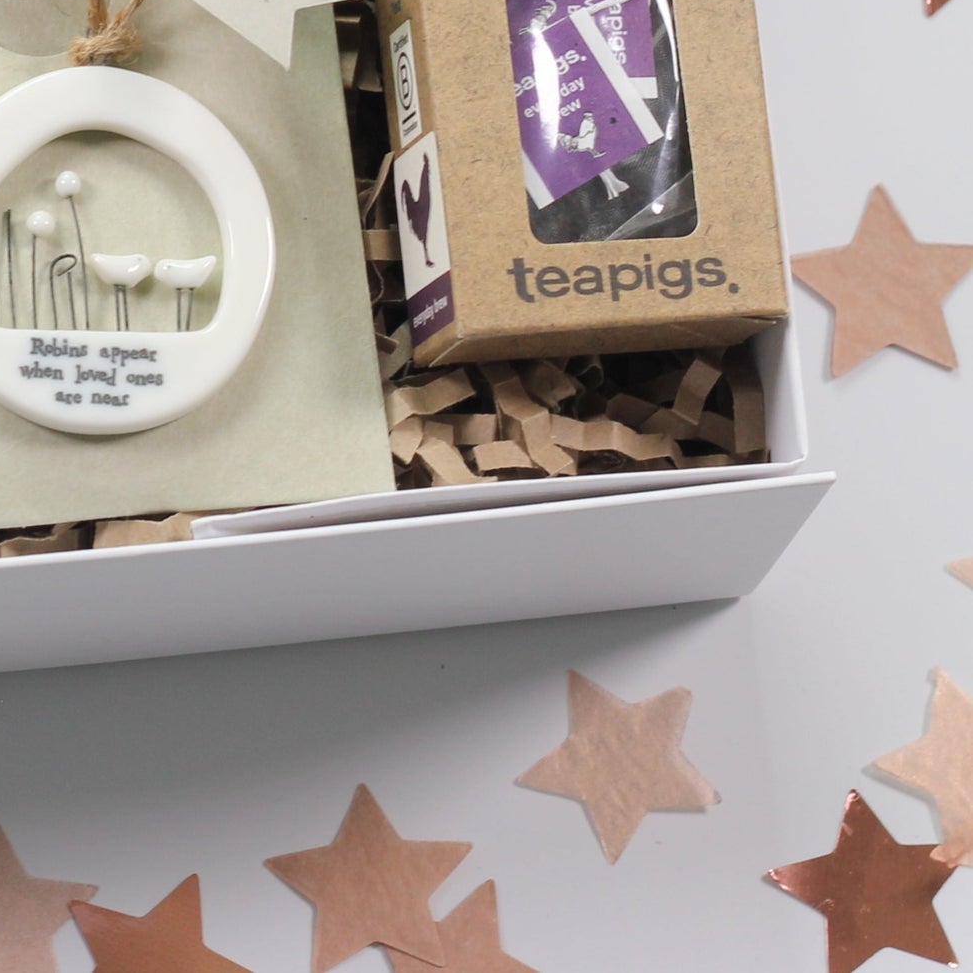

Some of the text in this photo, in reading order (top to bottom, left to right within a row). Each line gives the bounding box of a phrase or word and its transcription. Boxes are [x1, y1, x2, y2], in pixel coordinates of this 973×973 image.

[507, 253, 740, 304] teapigs.
[30, 337, 158, 367] Robins appear
[19, 361, 164, 386] when loved ones
[55, 390, 131, 407] are near
